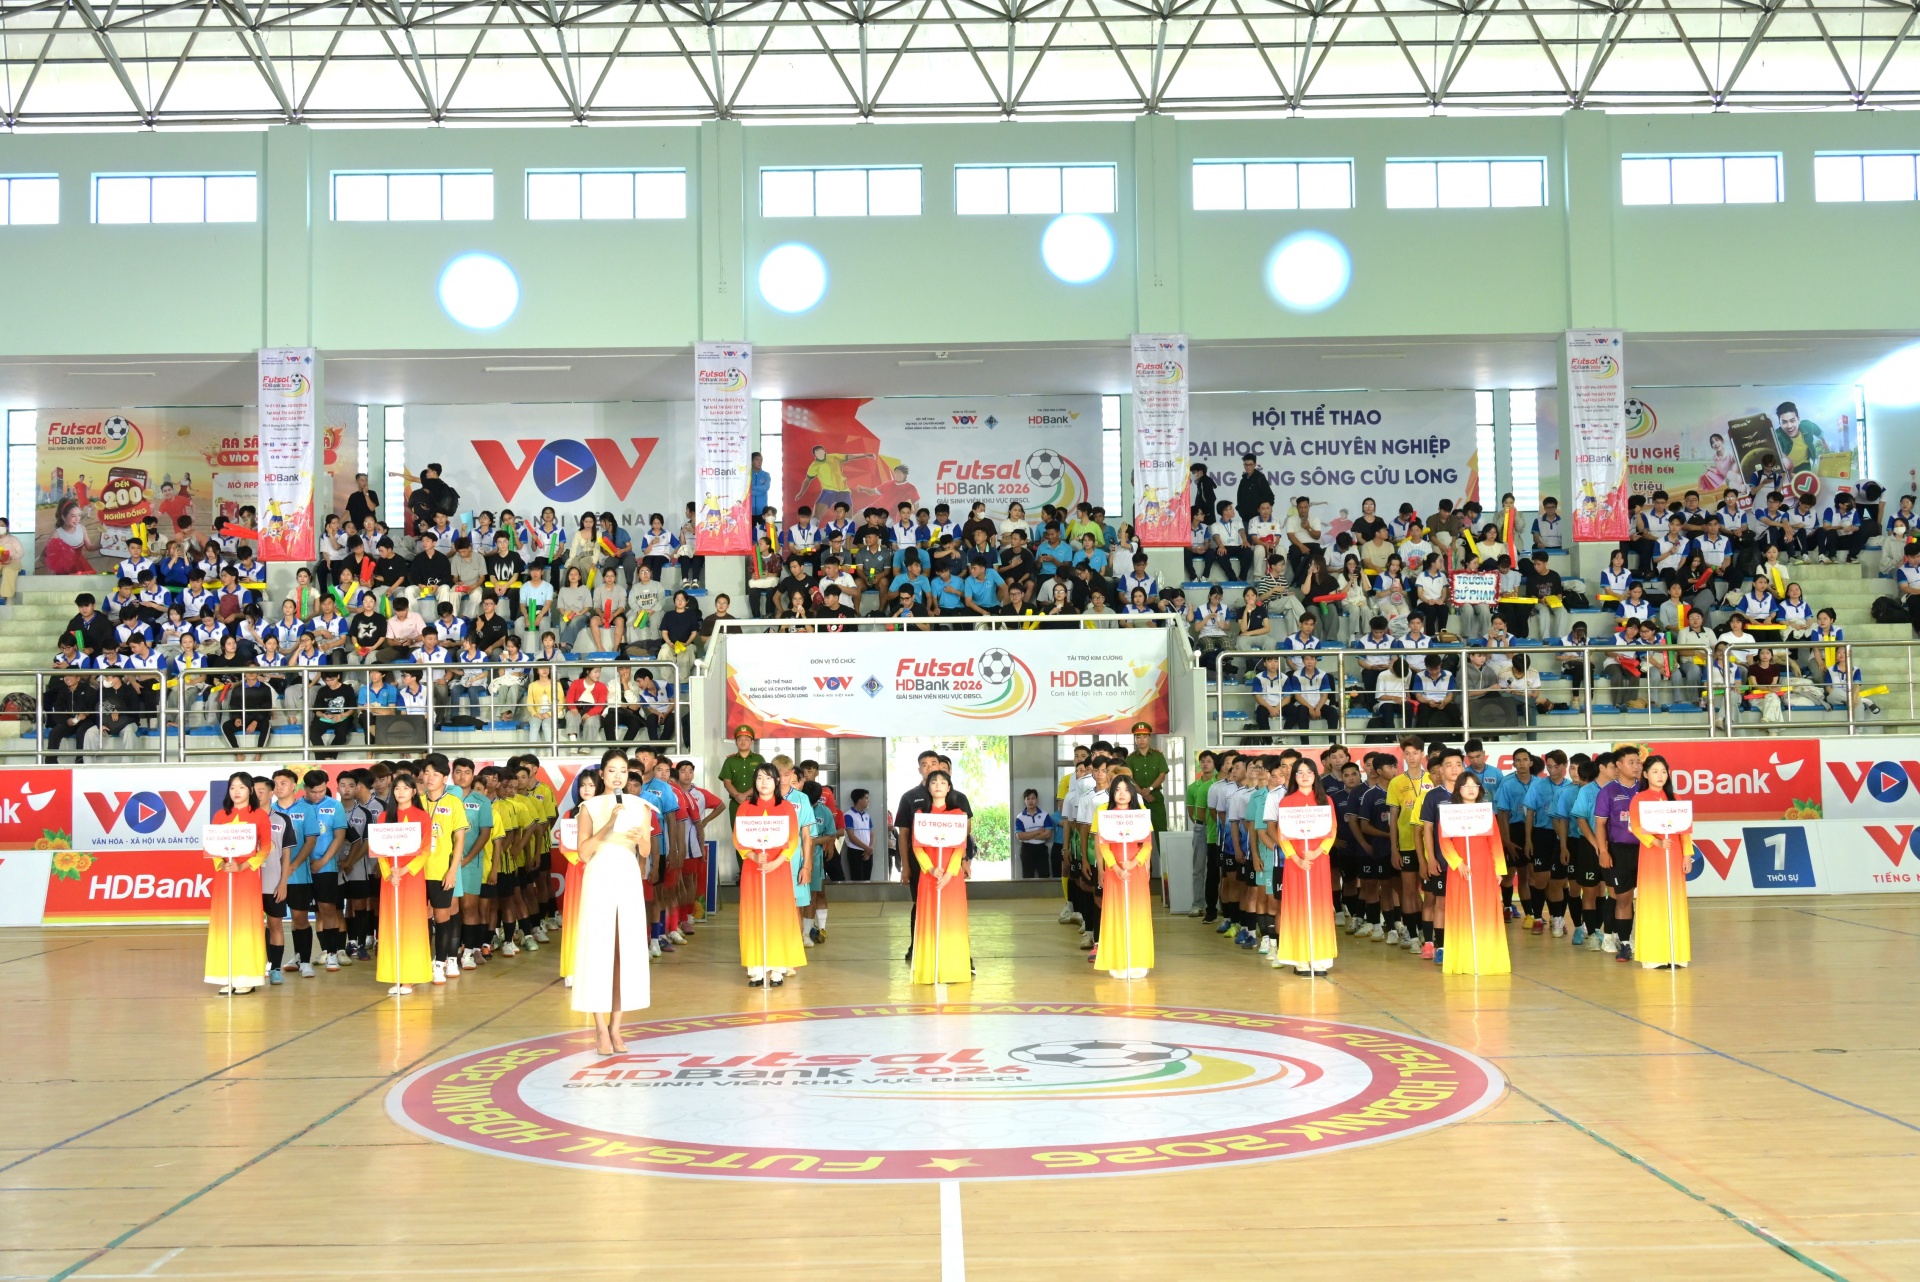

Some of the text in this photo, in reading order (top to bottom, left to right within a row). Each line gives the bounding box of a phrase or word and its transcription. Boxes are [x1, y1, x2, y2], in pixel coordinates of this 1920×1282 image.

[952, 416, 977, 424] VOV
[1028, 415, 1068, 424] HDBank
[1252, 404, 1381, 430] HỘI THỂ THAO
[48, 422, 102, 435] Futsal
[1189, 435, 1450, 460] ĐẠI VÀ CHUYÊN NGHIỆP
[1643, 445, 1680, 461] NGHỆ
[470, 438, 659, 503] VOV
[936, 459, 1021, 480] Futsal
[1300, 466, 1458, 485] SÔNG CỬU LONG
[936, 482, 1030, 495] HDBank 2026
[1633, 480, 1662, 494] triệu
[103, 486, 142, 510] 200
[104, 508, 147, 520] NGHÌN ĐỒNG
[896, 658, 974, 677] Futsal
[813, 676, 853, 690] VOV
[896, 679, 982, 691] HDBank 2026
[1050, 670, 1129, 687] HDBank
[1670, 769, 1770, 794] DBank
[83, 790, 207, 834] VOV
[92, 837, 199, 845] VĂN HÓA XÃ HỘI VÀ DÂN TỘC
[1402, 856, 1410, 864] 15
[1764, 834, 1786, 870] 1
[1788, 874, 1799, 883] SỰ
[1873, 872, 1911, 883] TIẾNG
[89, 874, 214, 900] HDBank
[617, 1005, 1290, 1038] FUTSAL HDBANK 2026
[582, 1048, 985, 1069] Futsal
[569, 1065, 1031, 1080] HDBank 2026
[562, 1080, 622, 1088] GIẢI
[1031, 1034, 1459, 1168] FUTSAL HDBANK 2026
[432, 1048, 886, 1172] FUTSAL HDBANK 2026
